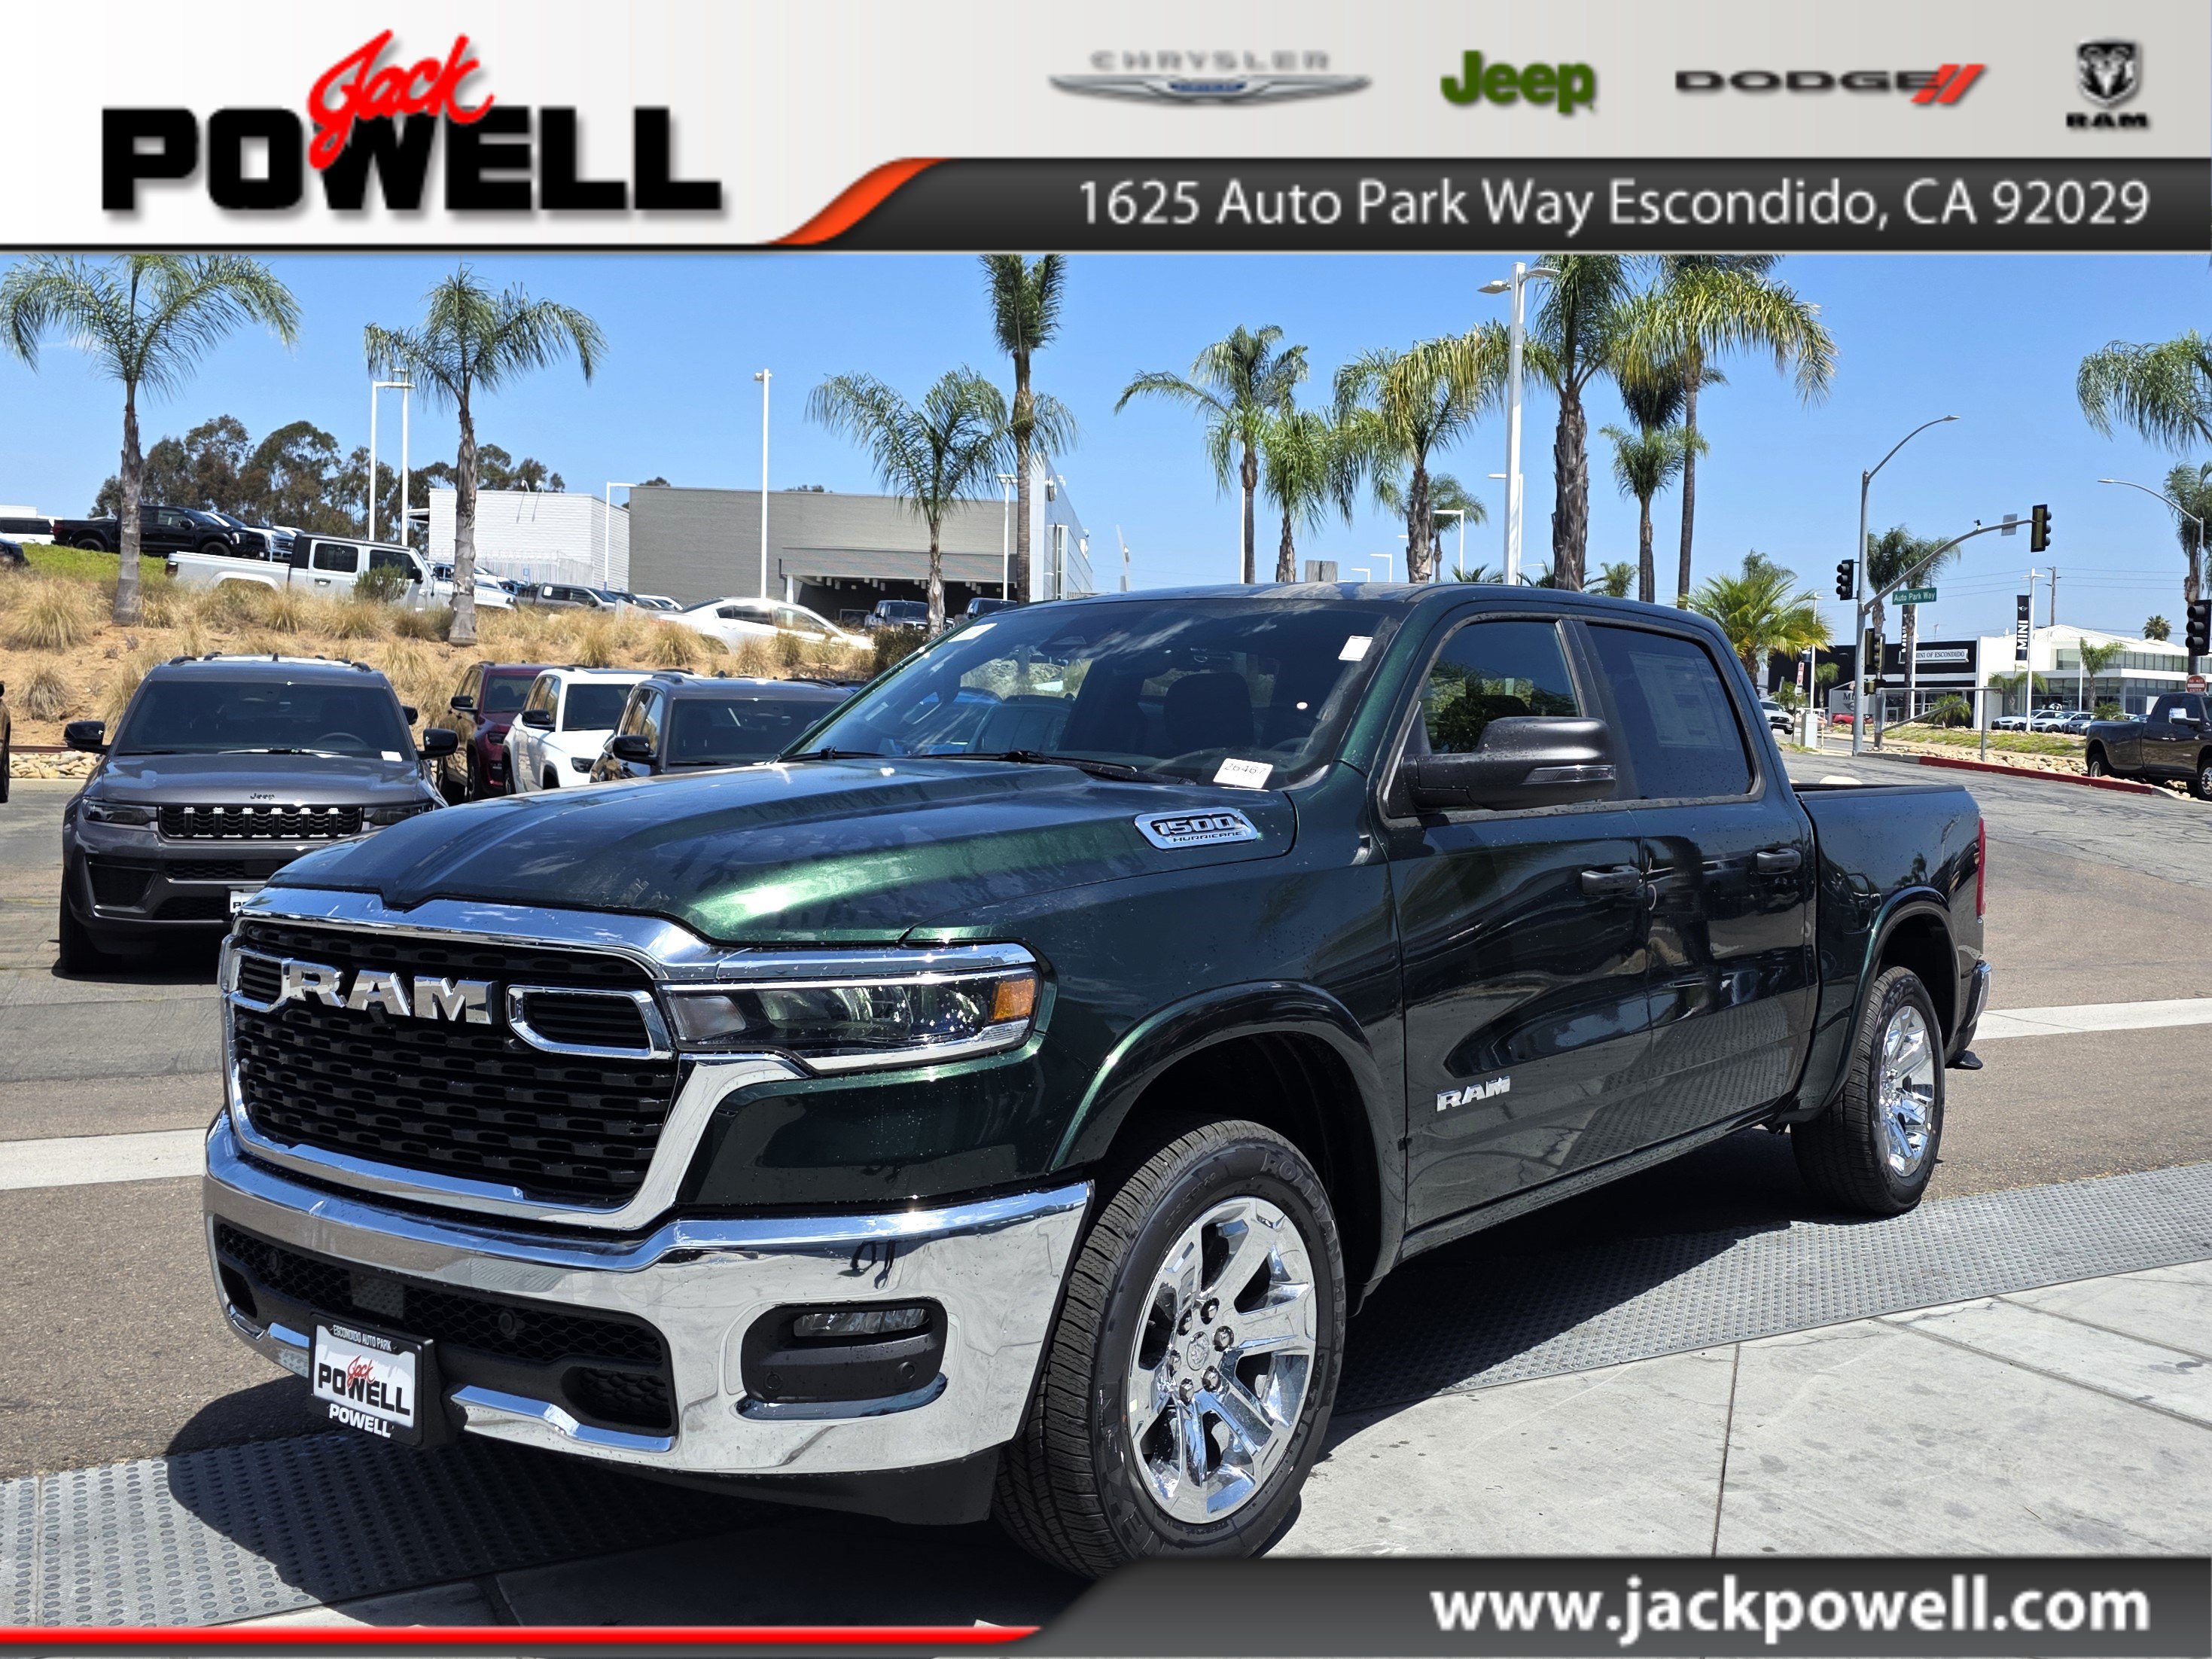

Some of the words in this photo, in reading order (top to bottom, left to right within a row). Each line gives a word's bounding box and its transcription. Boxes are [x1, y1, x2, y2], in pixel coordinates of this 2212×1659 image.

[1909, 592, 1922, 601] Park
[1923, 591, 1936, 600] Way
[2016, 620, 2029, 650] MINI
[1158, 816, 1238, 836] 1500
[1173, 831, 1243, 843] HURRICANE
[281, 958, 498, 1025] RAM
[1437, 1075, 1511, 1112] RAM
[333, 1324, 361, 1343] ESCONDIDO
[361, 1333, 376, 1348] AUTO
[376, 1337, 392, 1352] PARK
[346, 1355, 376, 1389] Jack
[318, 1362, 410, 1417] POWELL
[328, 1403, 392, 1438] POWELL
